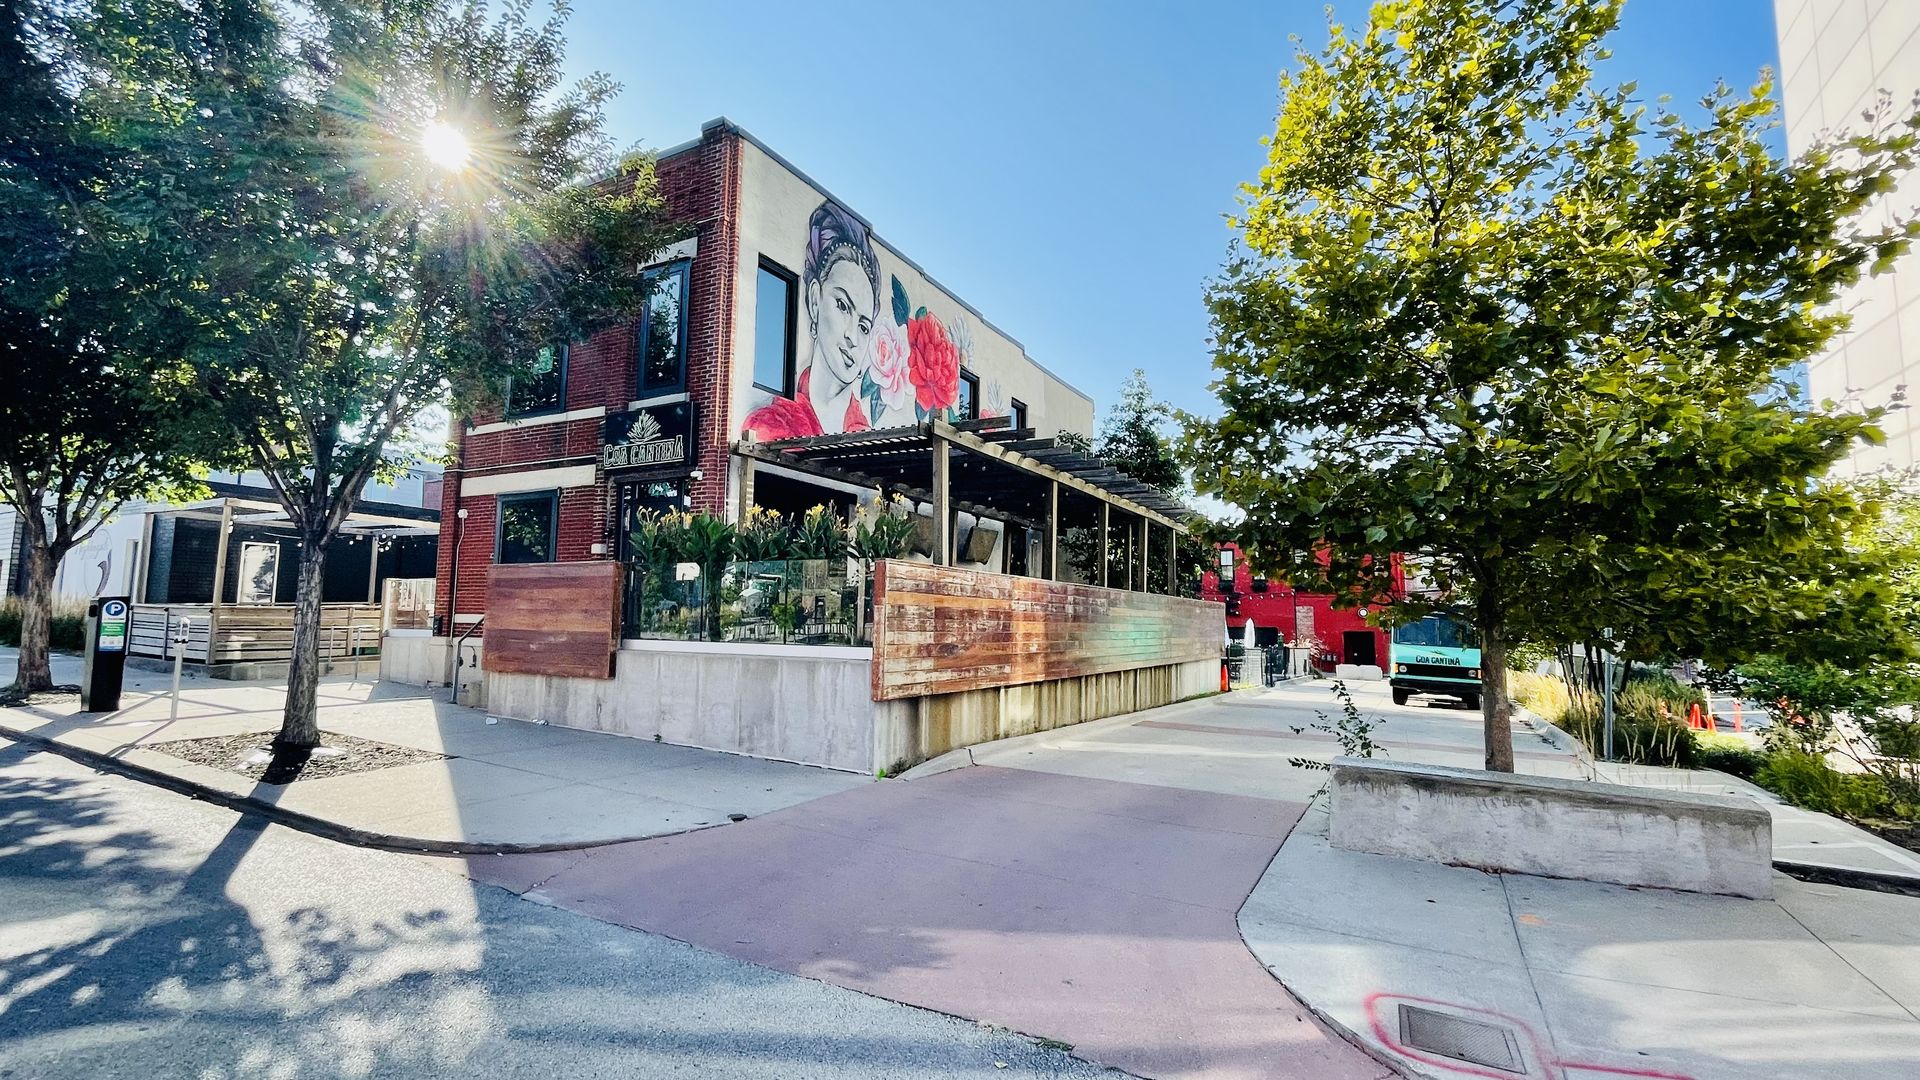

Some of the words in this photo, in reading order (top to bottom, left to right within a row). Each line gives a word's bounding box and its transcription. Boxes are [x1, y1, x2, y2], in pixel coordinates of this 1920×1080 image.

[604, 444, 628, 466] COA
[630, 434, 685, 464] CANTINA
[110, 604, 121, 614] P
[1415, 655, 1430, 664] COA
[1431, 656, 1461, 666] CANTINA
